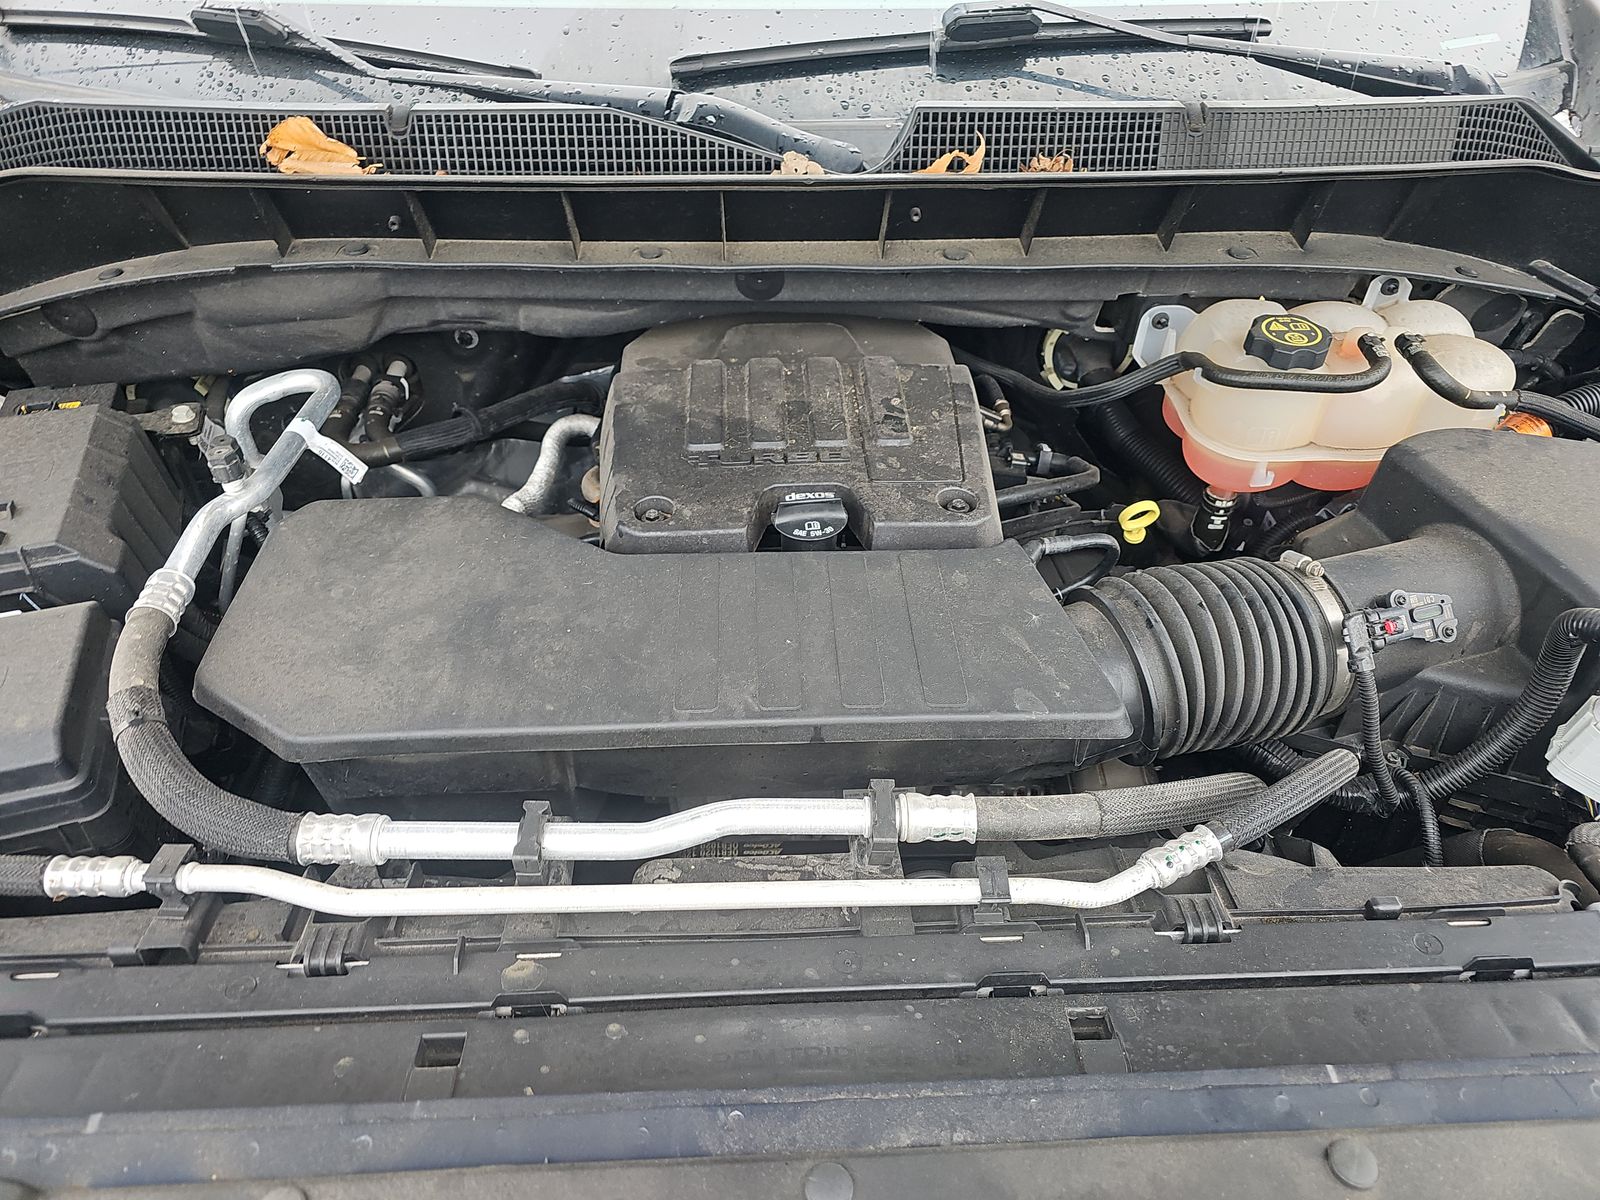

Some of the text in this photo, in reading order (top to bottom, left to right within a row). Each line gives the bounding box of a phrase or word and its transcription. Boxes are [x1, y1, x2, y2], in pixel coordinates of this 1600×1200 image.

[785, 492, 835, 501] dexos
[793, 526, 834, 537] SAE 5W-30
